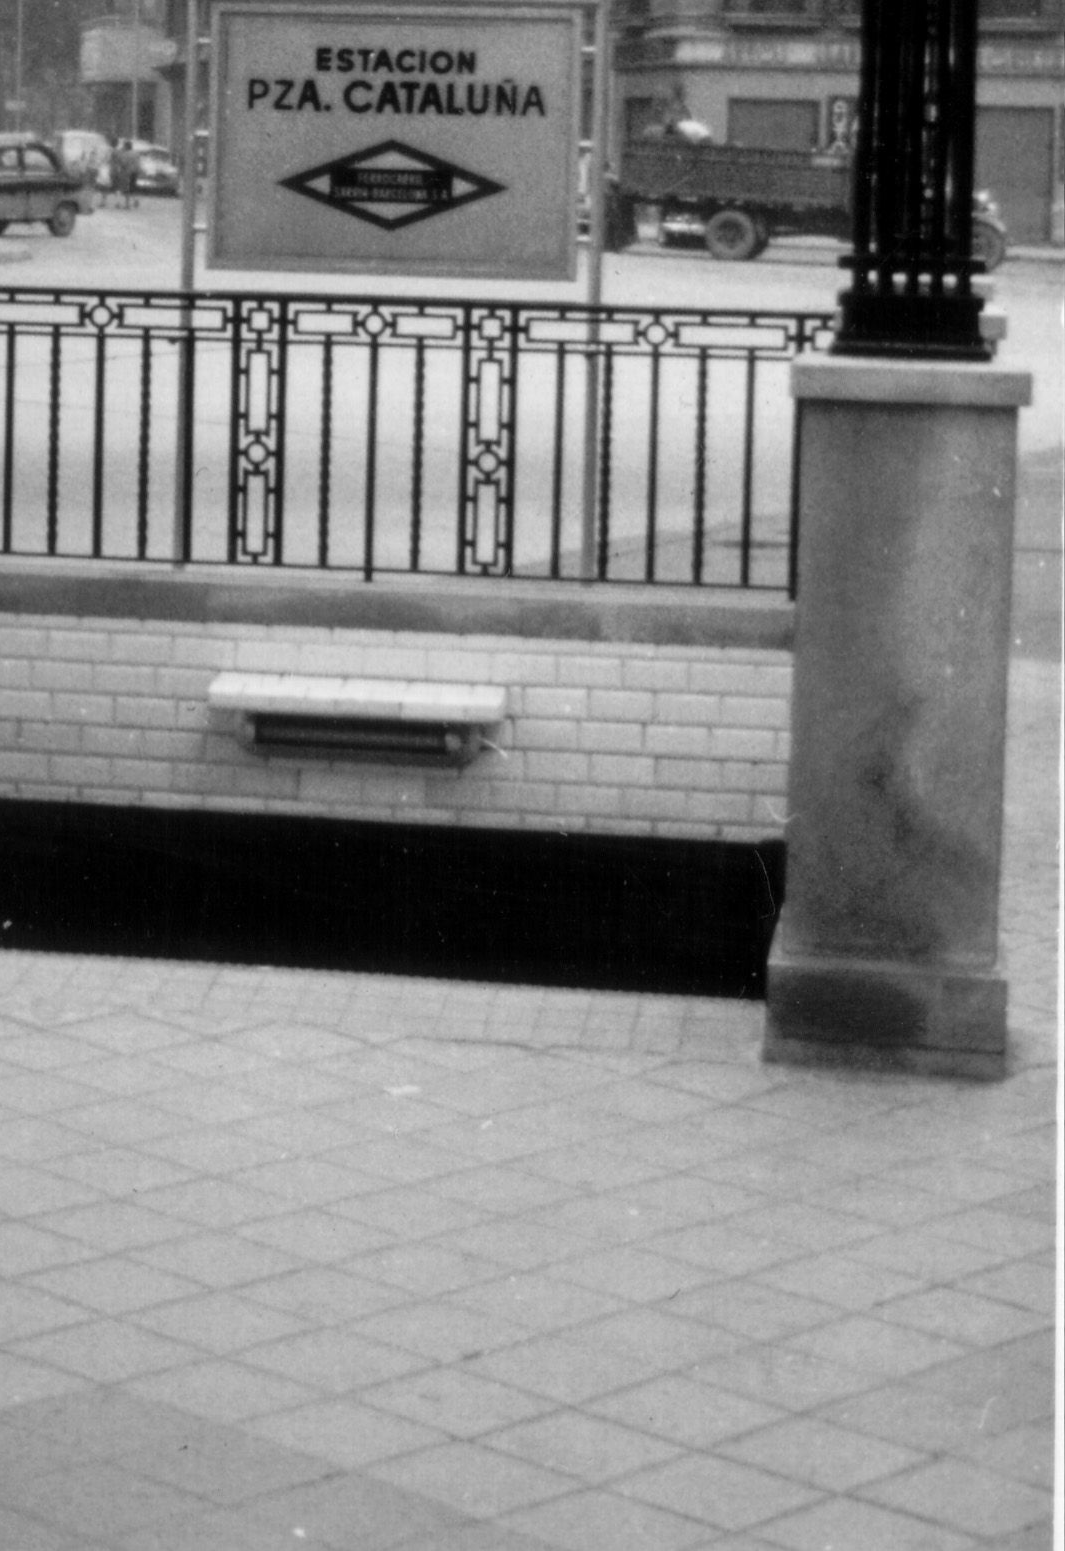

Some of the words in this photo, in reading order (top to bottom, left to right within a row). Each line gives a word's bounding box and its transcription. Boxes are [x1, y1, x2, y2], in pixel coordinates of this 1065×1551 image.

[316, 46, 477, 75] ESTACION
[247, 77, 332, 112] PZA.
[343, 77, 546, 117] CATALUÑA
